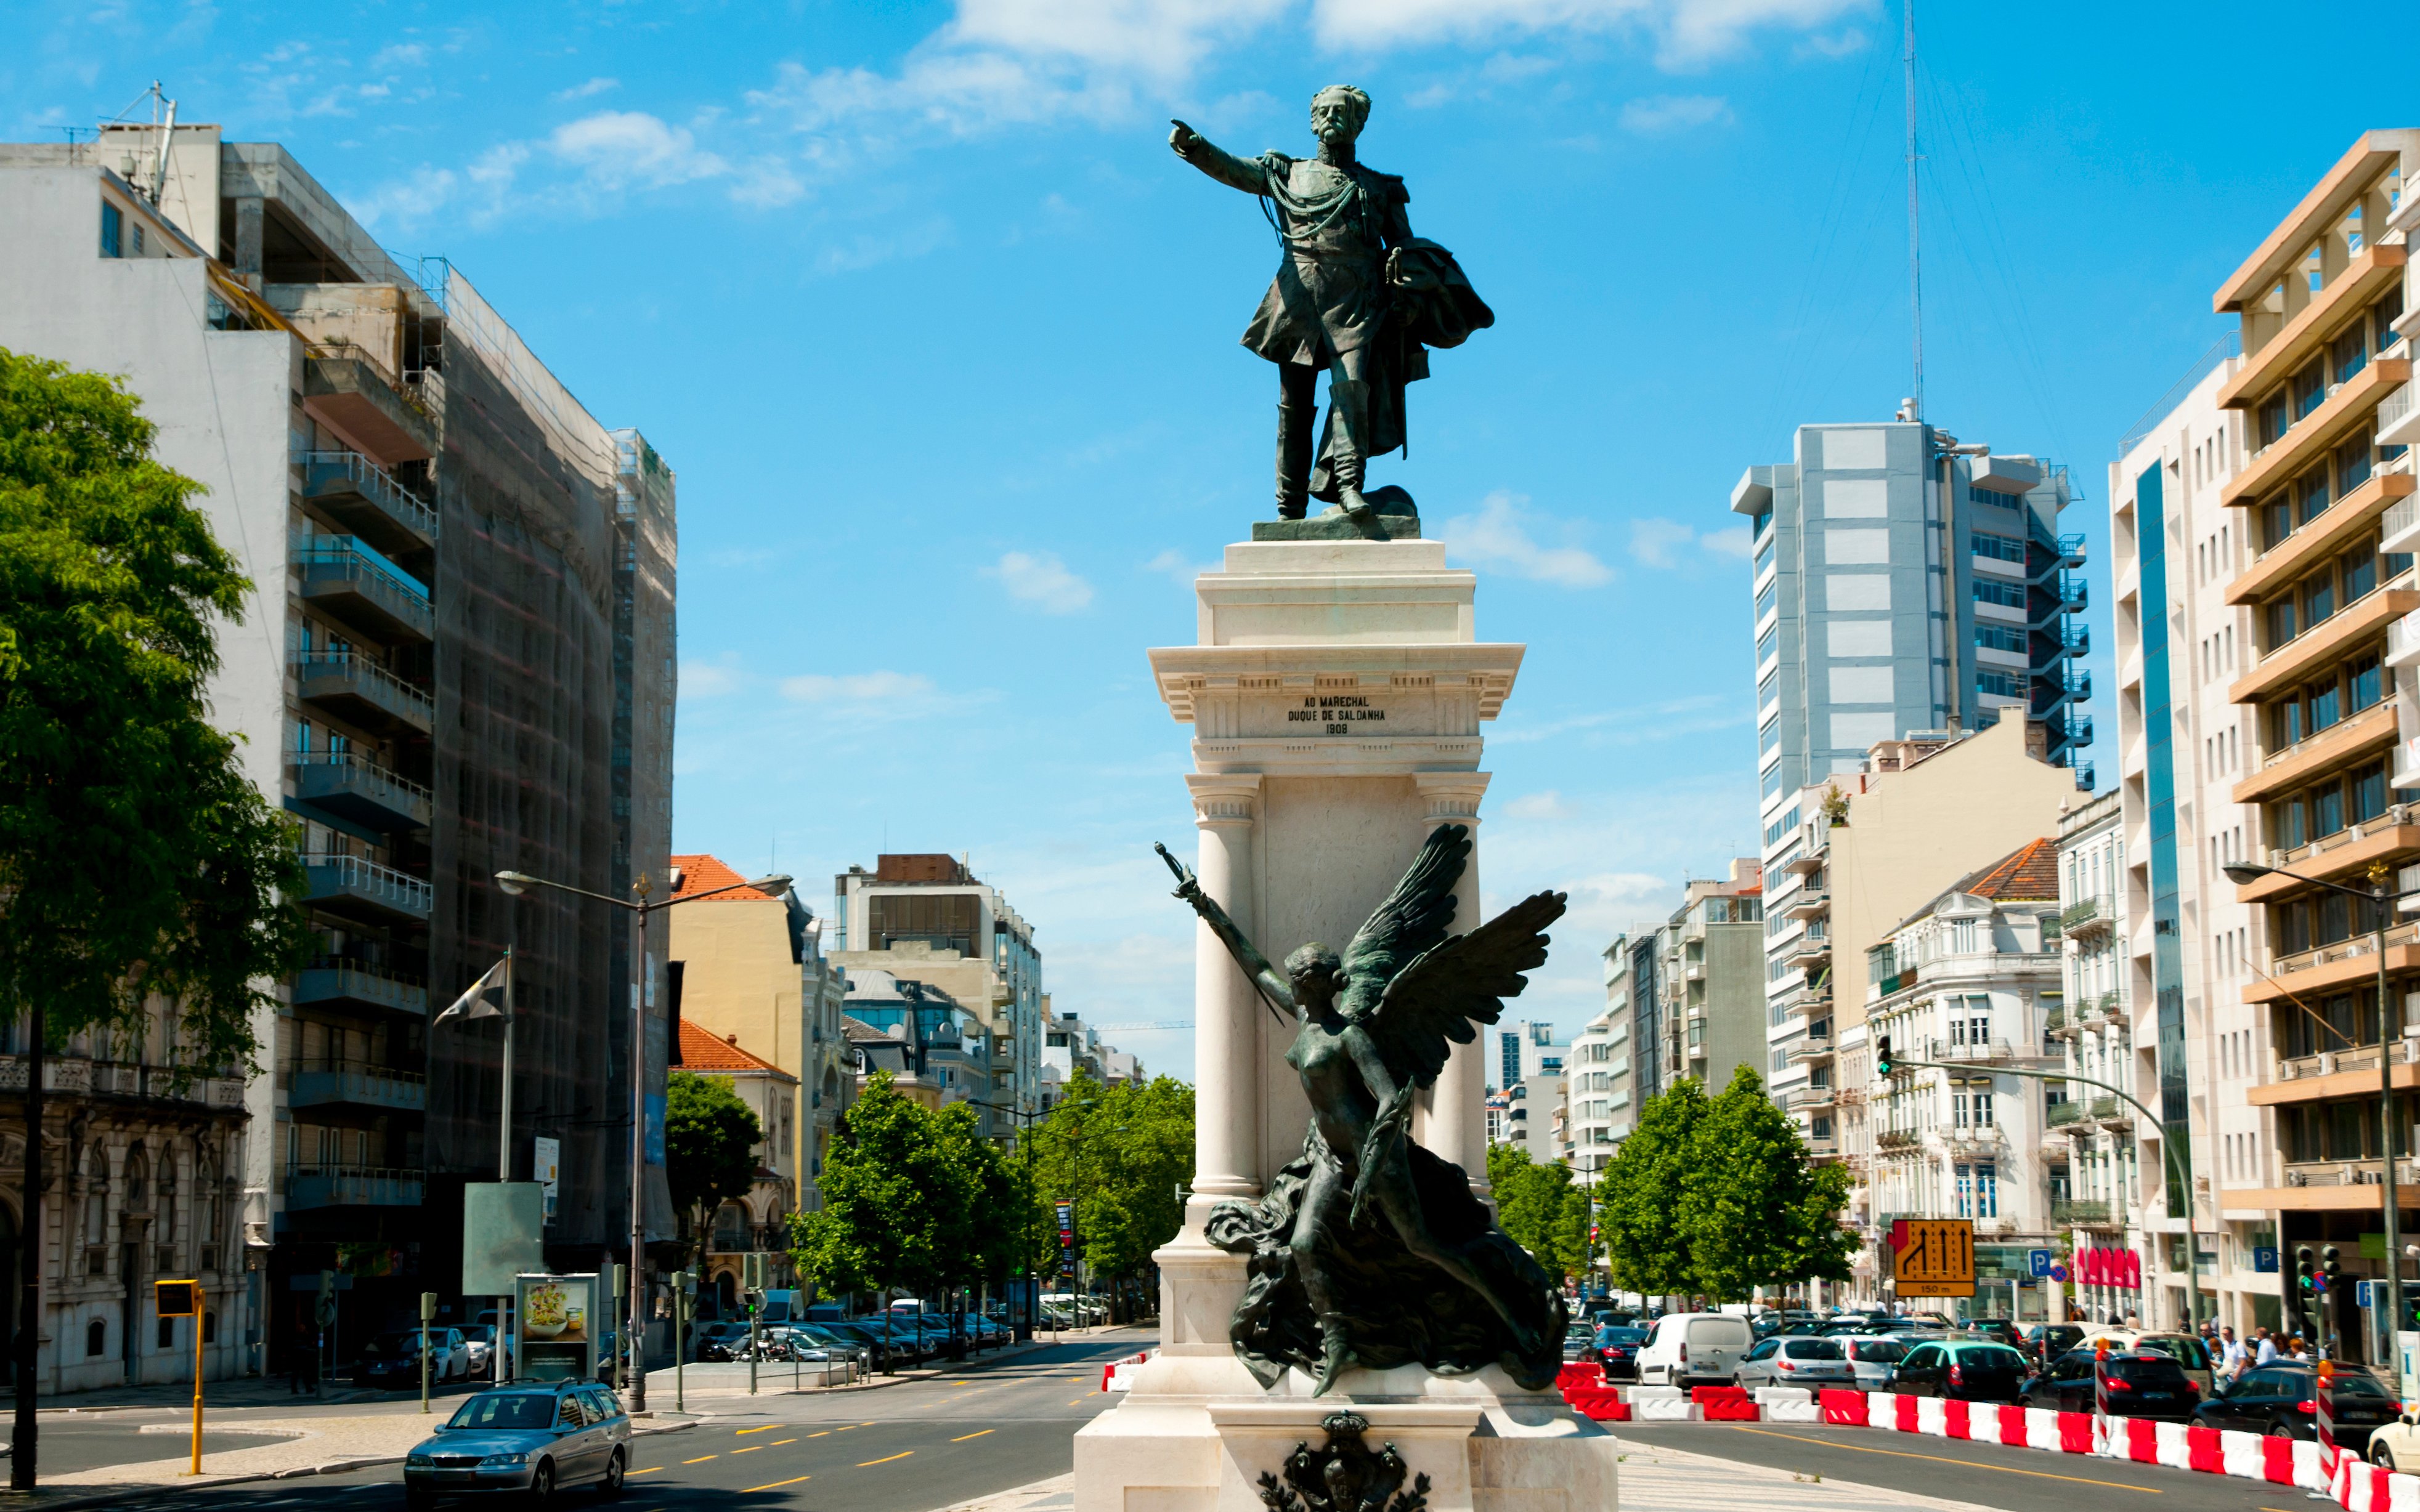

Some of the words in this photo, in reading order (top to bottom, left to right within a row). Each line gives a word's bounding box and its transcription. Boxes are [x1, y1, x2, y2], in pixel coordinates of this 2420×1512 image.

[1304, 697, 1315, 708] AO
[1320, 696, 1370, 707] MARECHAL
[1288, 710, 1317, 722] DUQUE
[1322, 710, 1334, 721] DE
[1338, 710, 1386, 721] SALDANHA
[2035, 1254, 2046, 1272] P
[2262, 1251, 2272, 1265] P
[1921, 1285, 1938, 1293] 150
